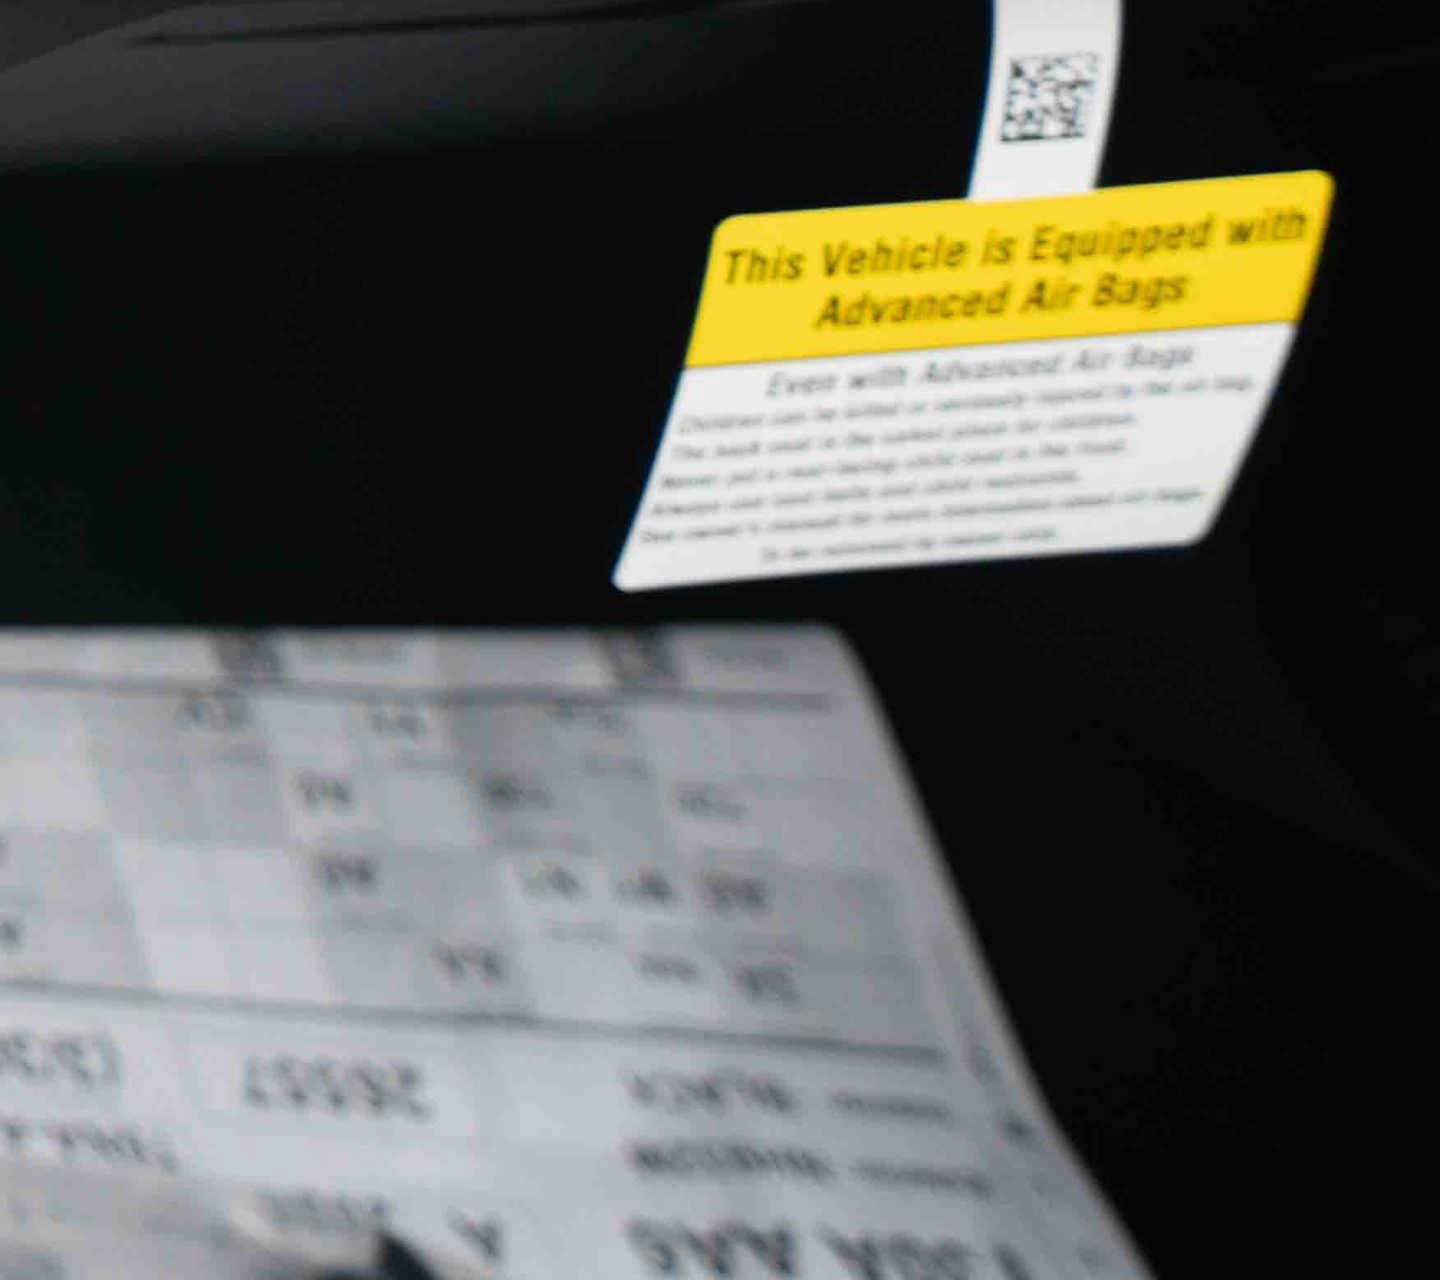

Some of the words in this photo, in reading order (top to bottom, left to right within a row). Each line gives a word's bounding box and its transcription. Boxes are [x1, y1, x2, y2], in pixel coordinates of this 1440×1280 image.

[724, 247, 804, 285] This
[820, 235, 968, 277] Vehicle
[980, 228, 1015, 265] is
[1030, 213, 1216, 265] Equipped
[1228, 207, 1307, 245] with
[813, 281, 1013, 330] Advanced
[1019, 278, 1081, 313] Air
[1092, 272, 1190, 312] Bags
